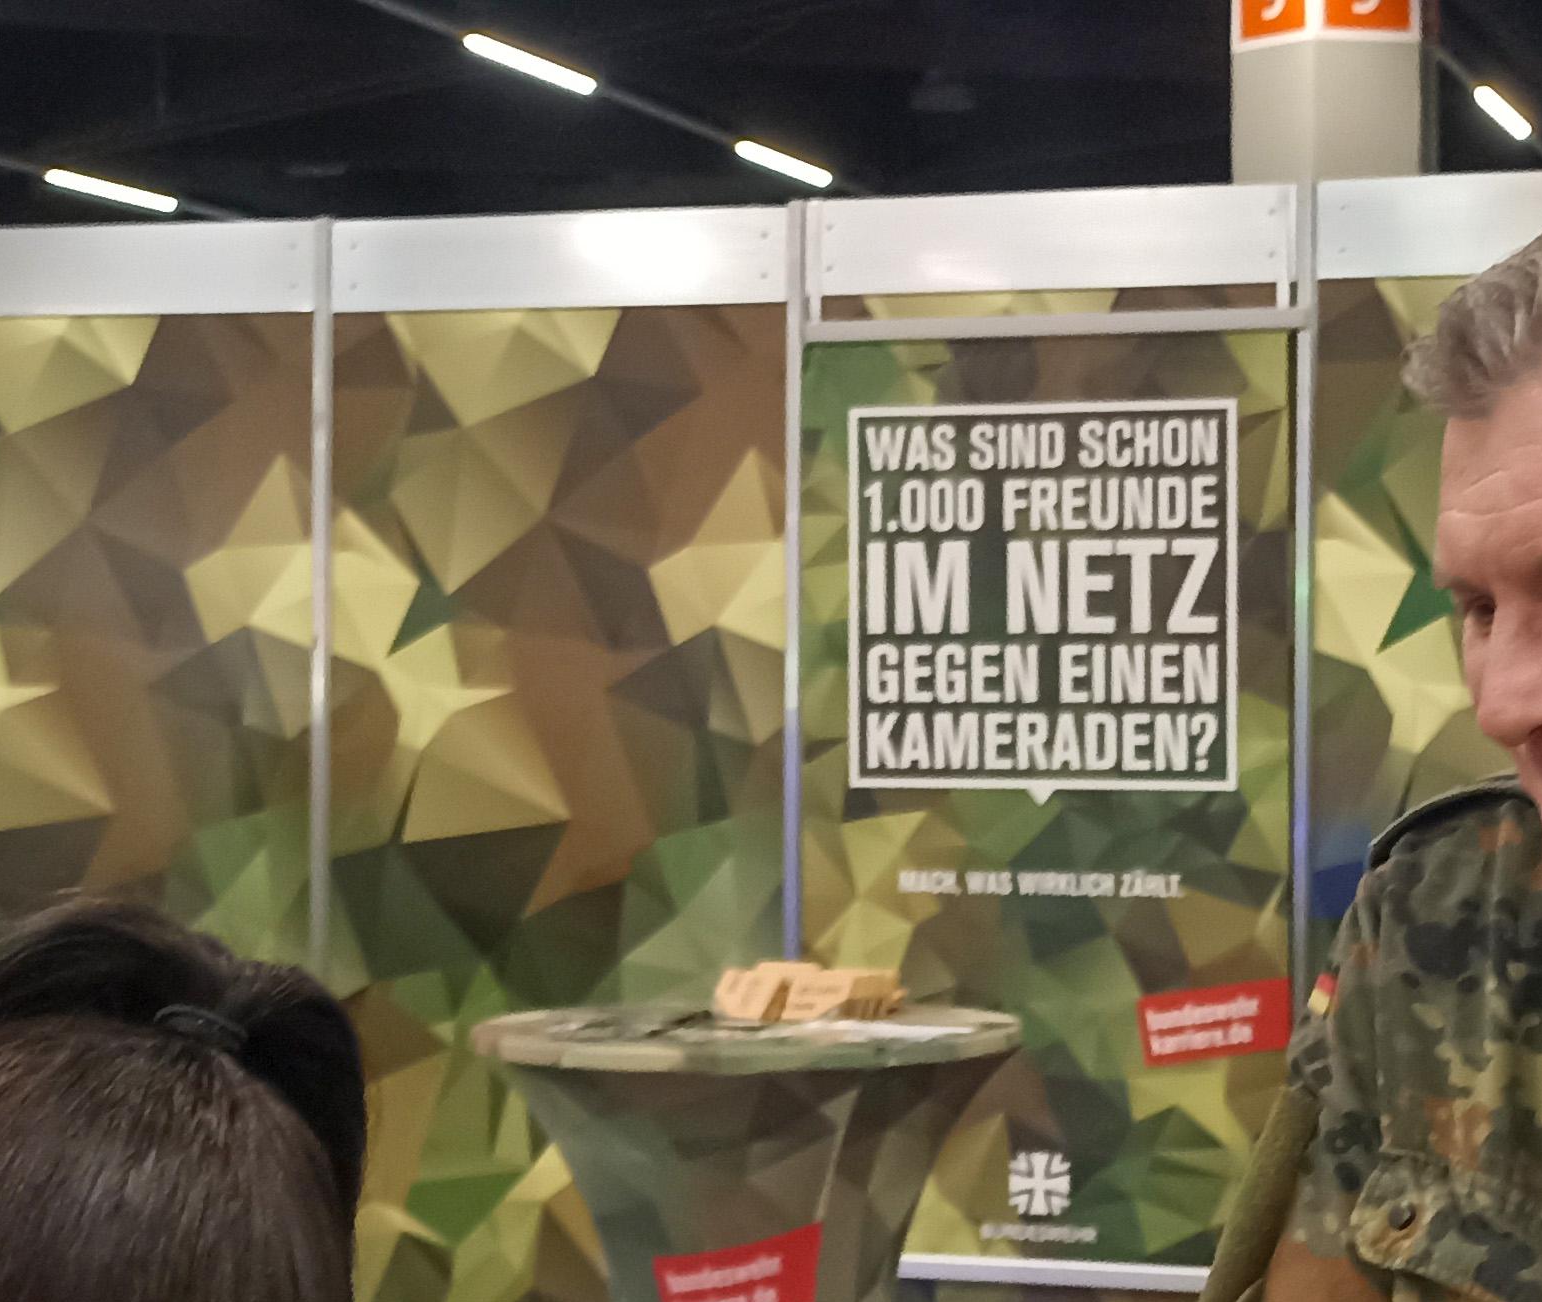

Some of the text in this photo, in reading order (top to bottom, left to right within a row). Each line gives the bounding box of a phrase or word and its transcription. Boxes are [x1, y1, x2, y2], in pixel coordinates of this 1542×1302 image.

[865, 416, 1219, 472] WAS SIND SCHON
[863, 474, 1219, 533] 1.000 FREUNDE
[865, 536, 1219, 636] IM NETZ
[865, 642, 1219, 705] GEGEN EINEN
[865, 711, 1218, 773] KAMERADEN?
